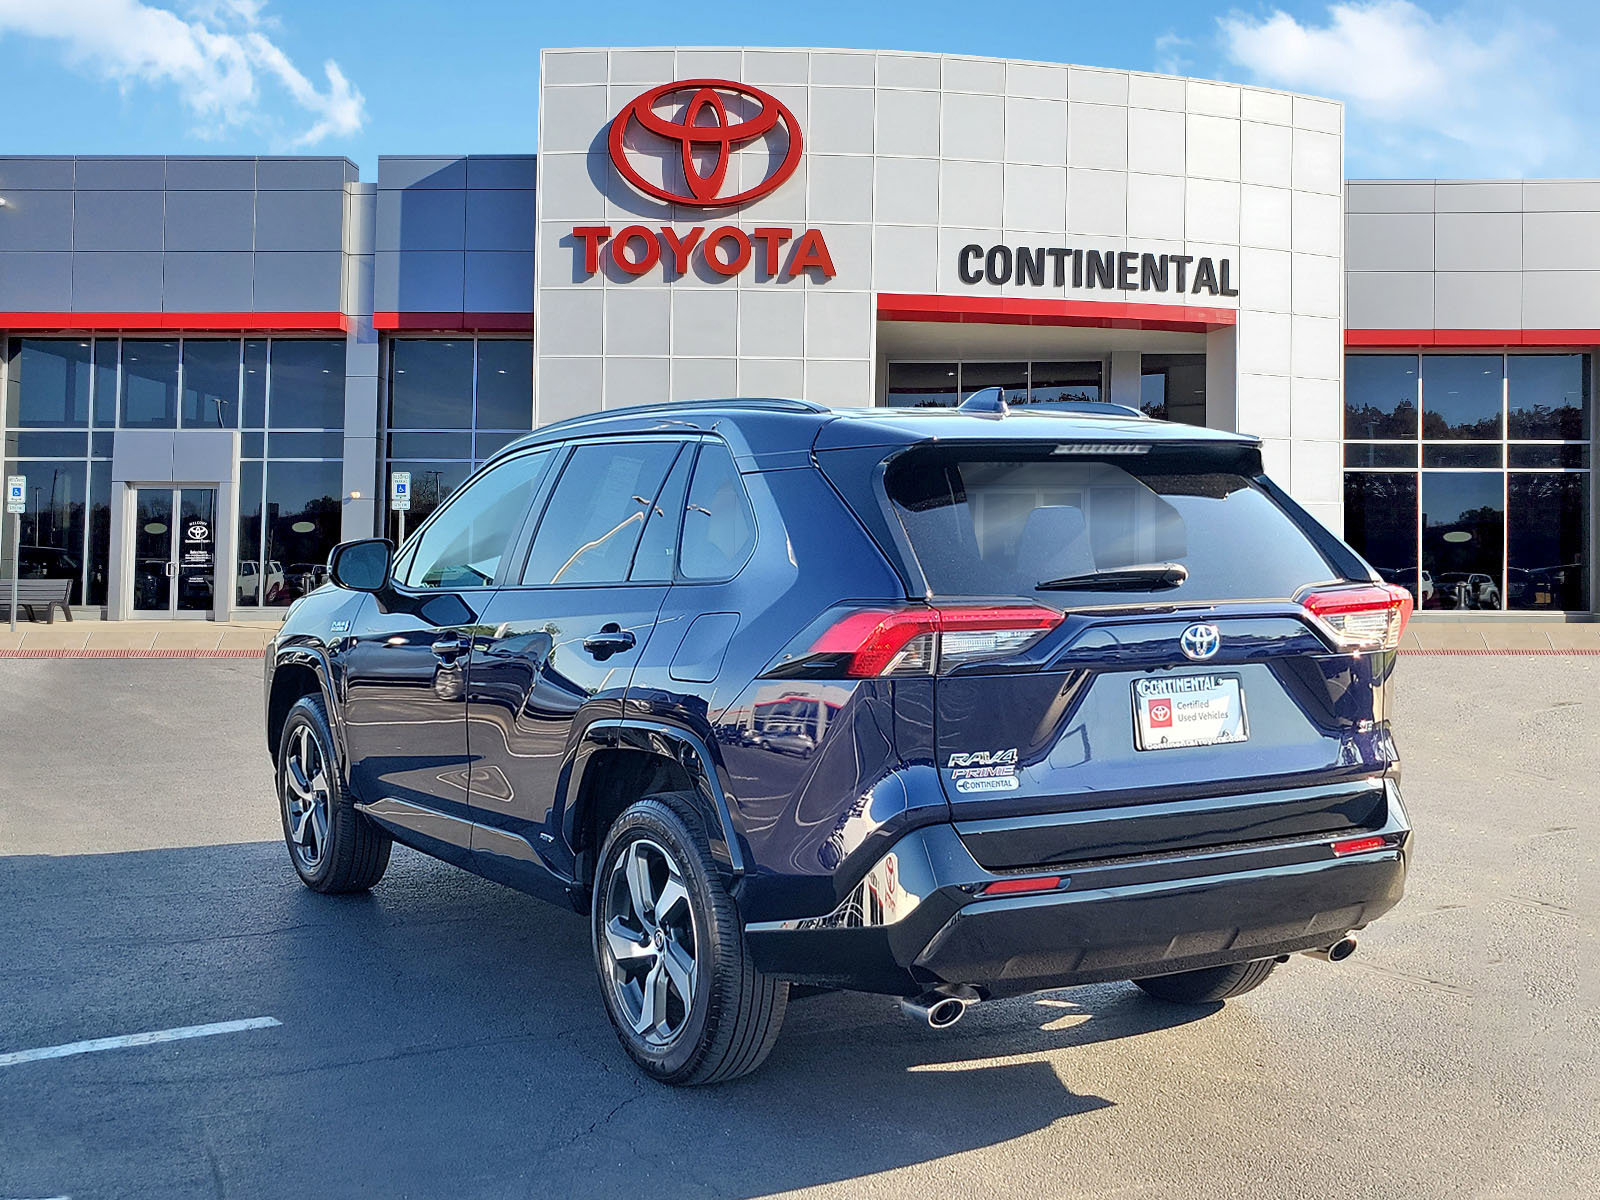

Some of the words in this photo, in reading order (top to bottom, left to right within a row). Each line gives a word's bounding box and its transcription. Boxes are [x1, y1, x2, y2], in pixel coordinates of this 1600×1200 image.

[573, 225, 837, 276] TOYOTA
[959, 244, 1239, 297] CONTINENTAL
[1137, 676, 1217, 697] CONTINENTAL
[1177, 700, 1209, 710] Certified
[1178, 713, 1197, 722] Used
[1199, 711, 1229, 721] Vehicles
[948, 748, 1018, 768] RAV4
[951, 765, 1016, 780] PRIME
[958, 780, 1013, 791] CONTINENTAL
